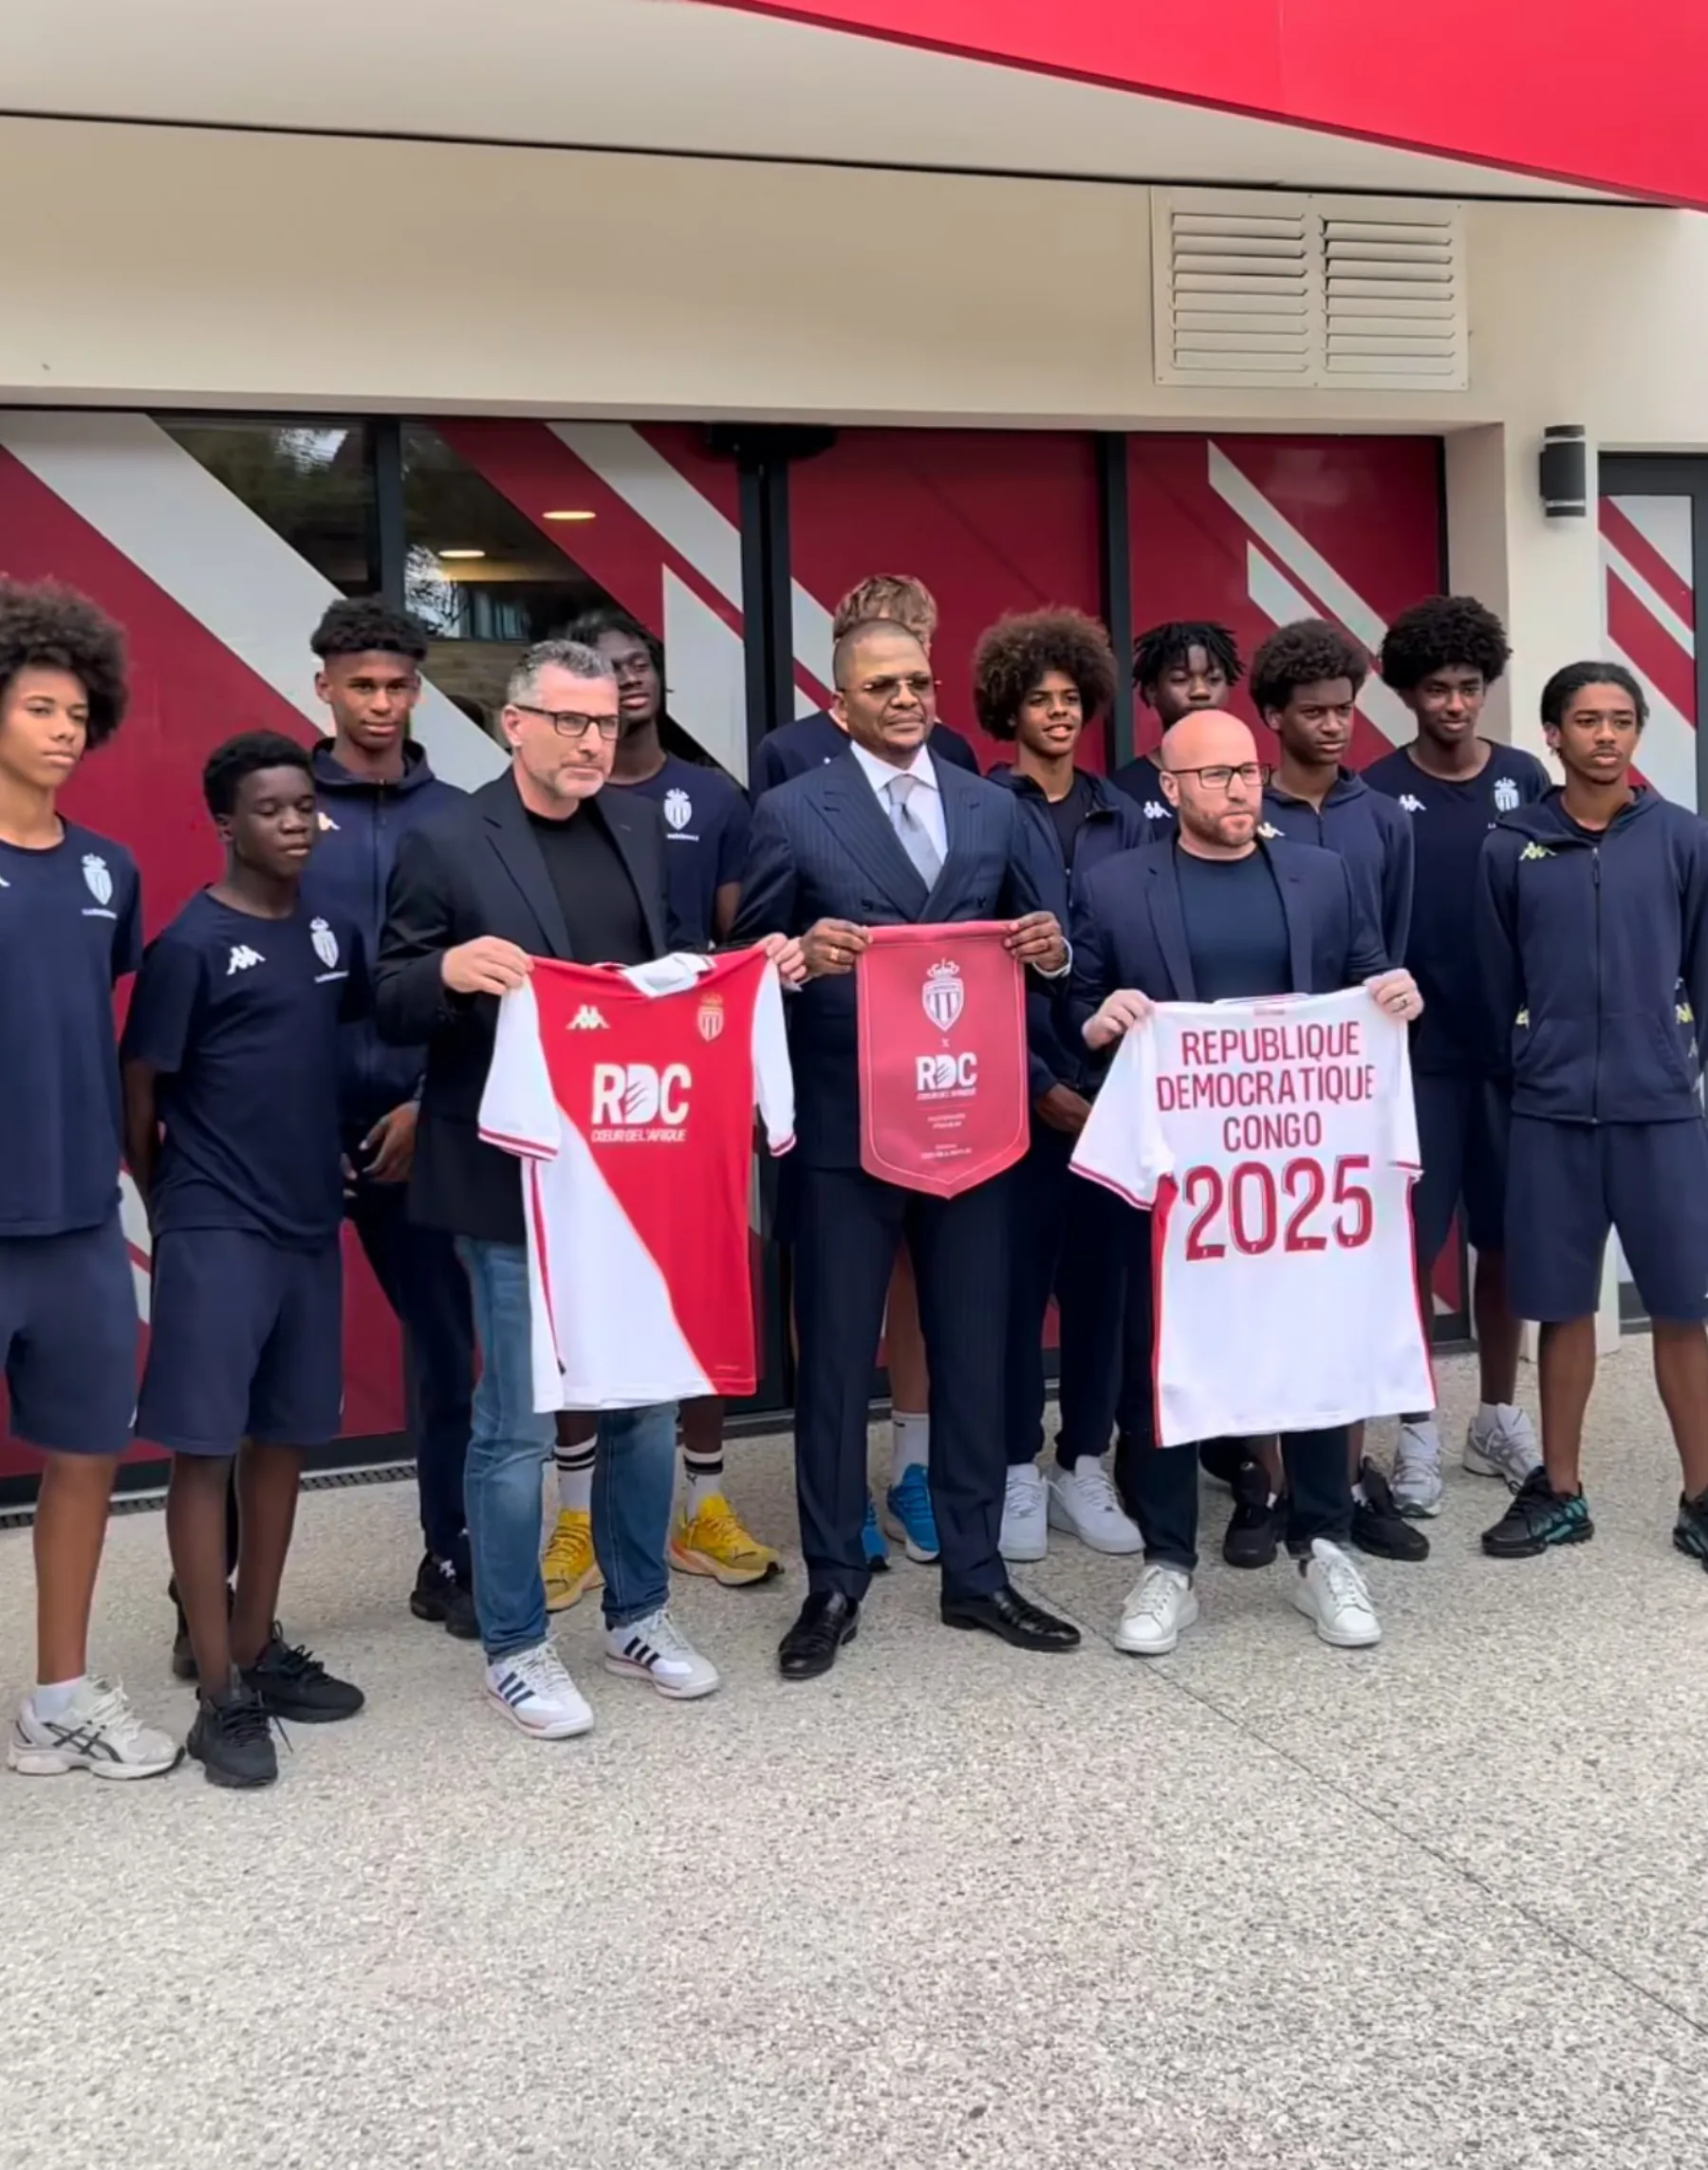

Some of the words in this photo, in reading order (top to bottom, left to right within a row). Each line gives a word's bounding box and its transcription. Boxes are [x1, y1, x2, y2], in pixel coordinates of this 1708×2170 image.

[1181, 1021, 1360, 1066] REPUBLIQUE
[591, 1063, 692, 1124] RDC
[915, 1052, 977, 1090] RDC
[1156, 1065, 1375, 1111] DEMOCRATIQUE
[1223, 1111, 1322, 1152] CONGO
[1182, 1155, 1373, 1261] 2025
